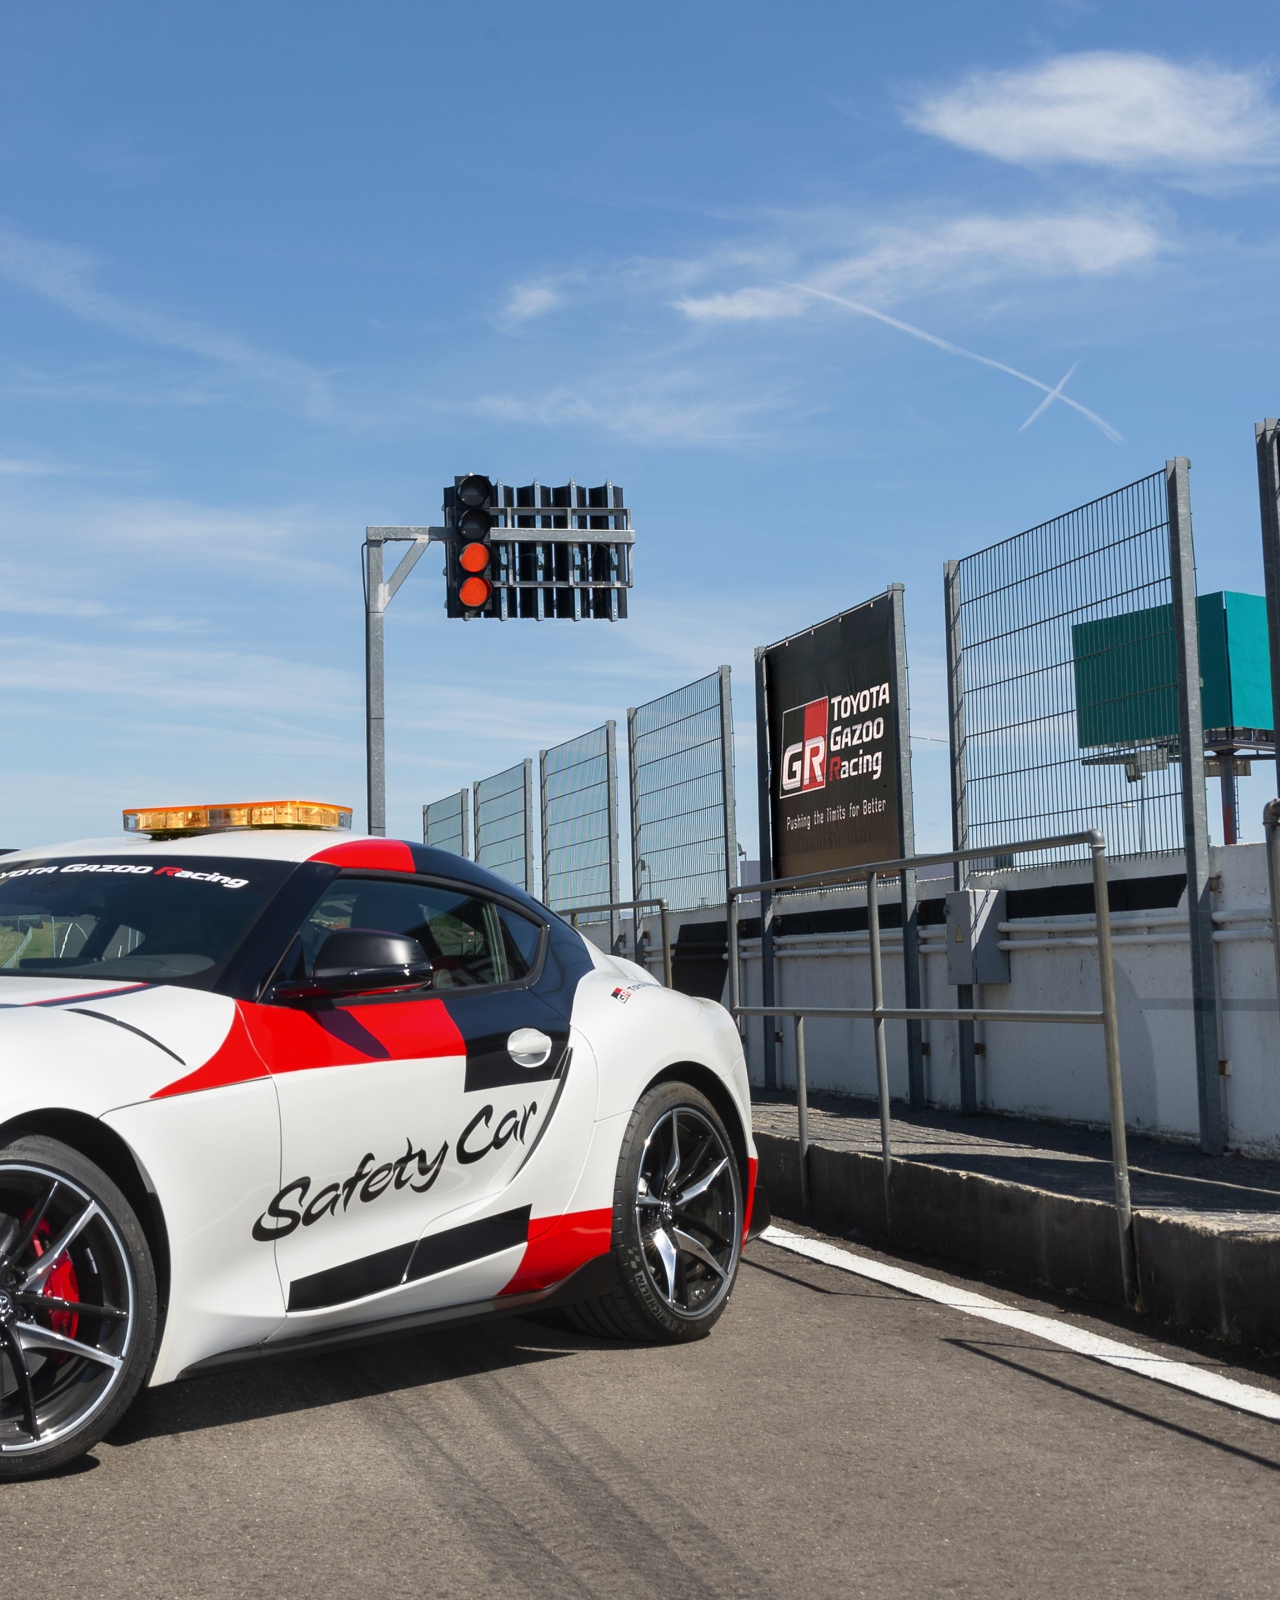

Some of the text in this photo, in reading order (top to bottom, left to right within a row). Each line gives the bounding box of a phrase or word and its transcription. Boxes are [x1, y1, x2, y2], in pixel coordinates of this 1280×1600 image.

[830, 682, 890, 721] TOYOTA
[830, 717, 884, 752] GAZOO
[782, 735, 825, 791] GR
[829, 749, 883, 781] Racing
[786, 799, 887, 831] Pushing the limits for Better
[60, 863, 153, 875] GAZOO
[154, 866, 249, 889] Racing
[251, 1100, 538, 1242] Safety Car
[635, 1273, 669, 1324] MICHELIN
